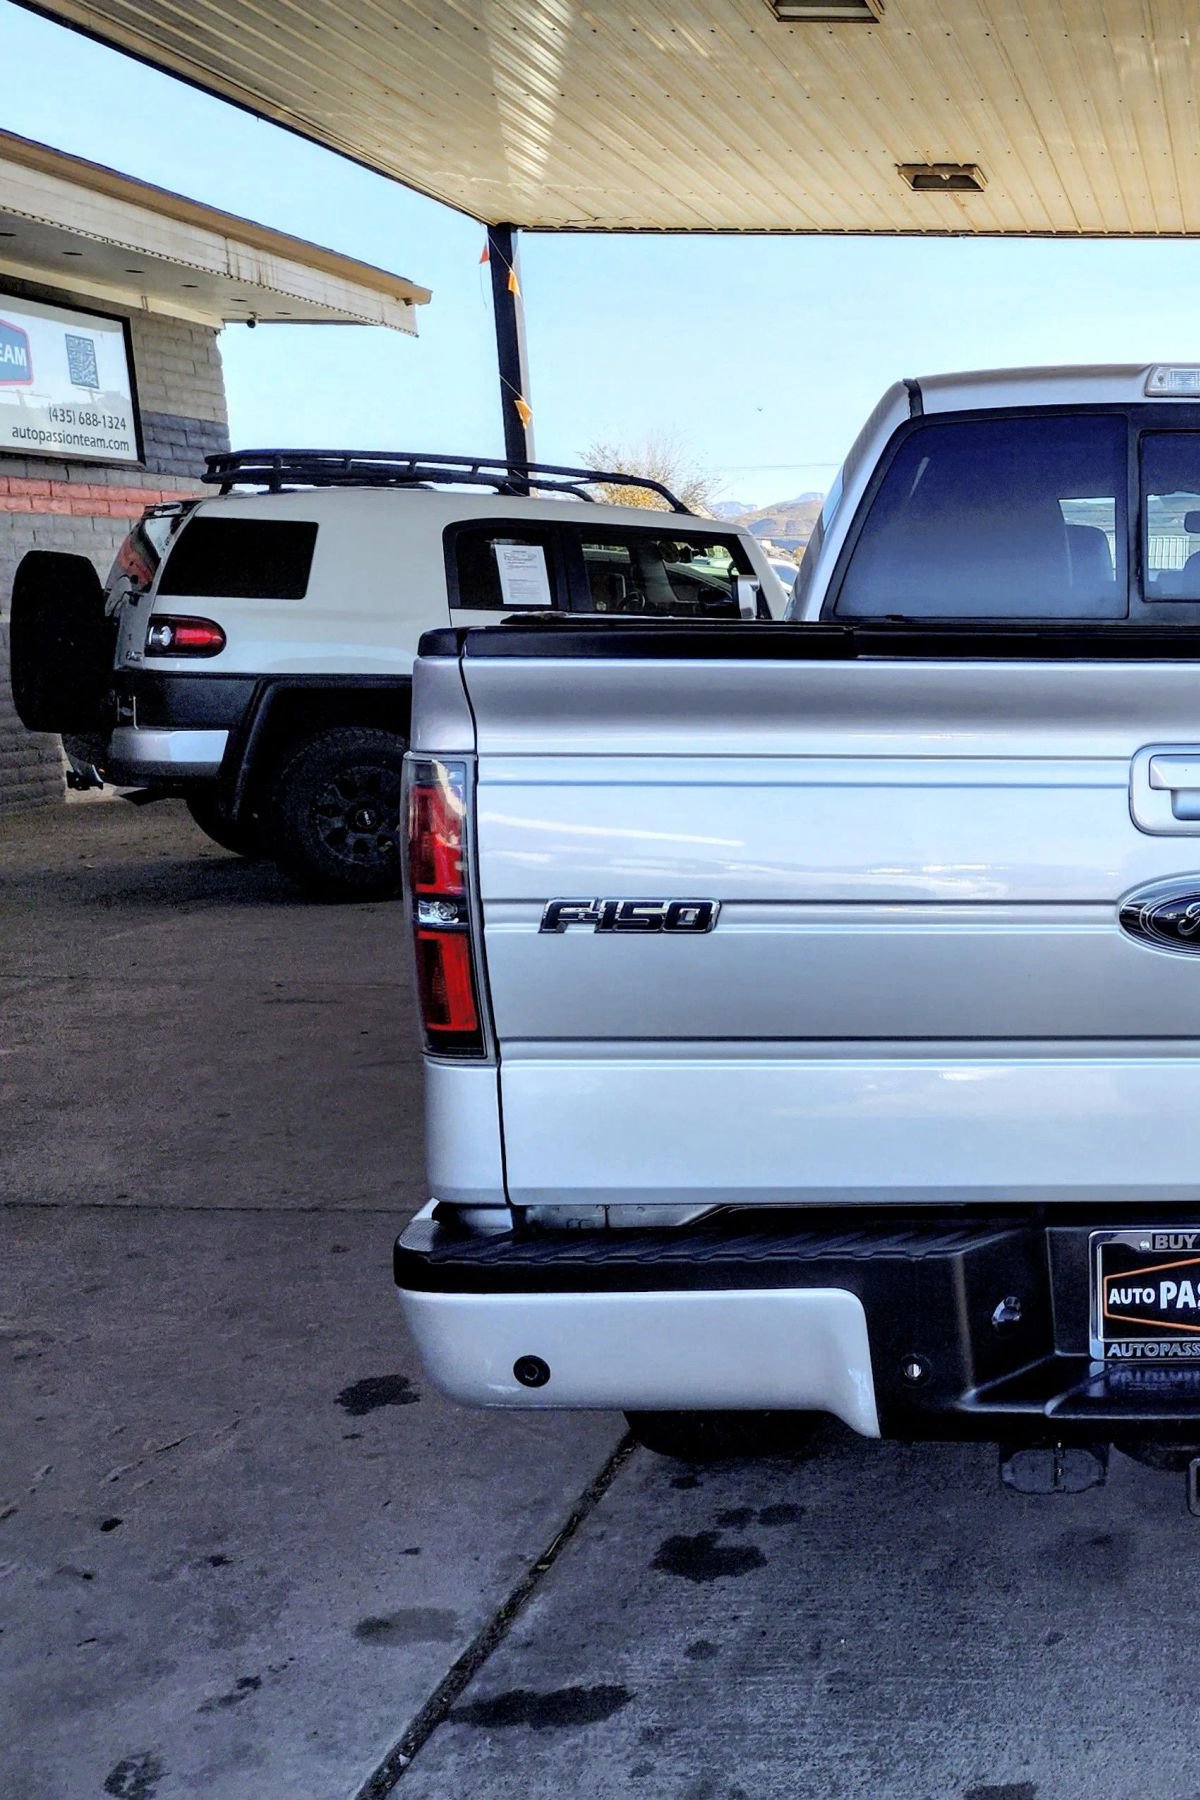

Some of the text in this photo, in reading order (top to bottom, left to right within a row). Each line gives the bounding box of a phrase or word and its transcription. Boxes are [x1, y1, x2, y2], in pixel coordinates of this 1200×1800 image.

[49, 407, 127, 430] (435) 688-1324
[12, 426, 130, 452] autopassionteam.com
[1154, 1233, 1197, 1250] BUY
[1108, 1287, 1155, 1305] AUTO
